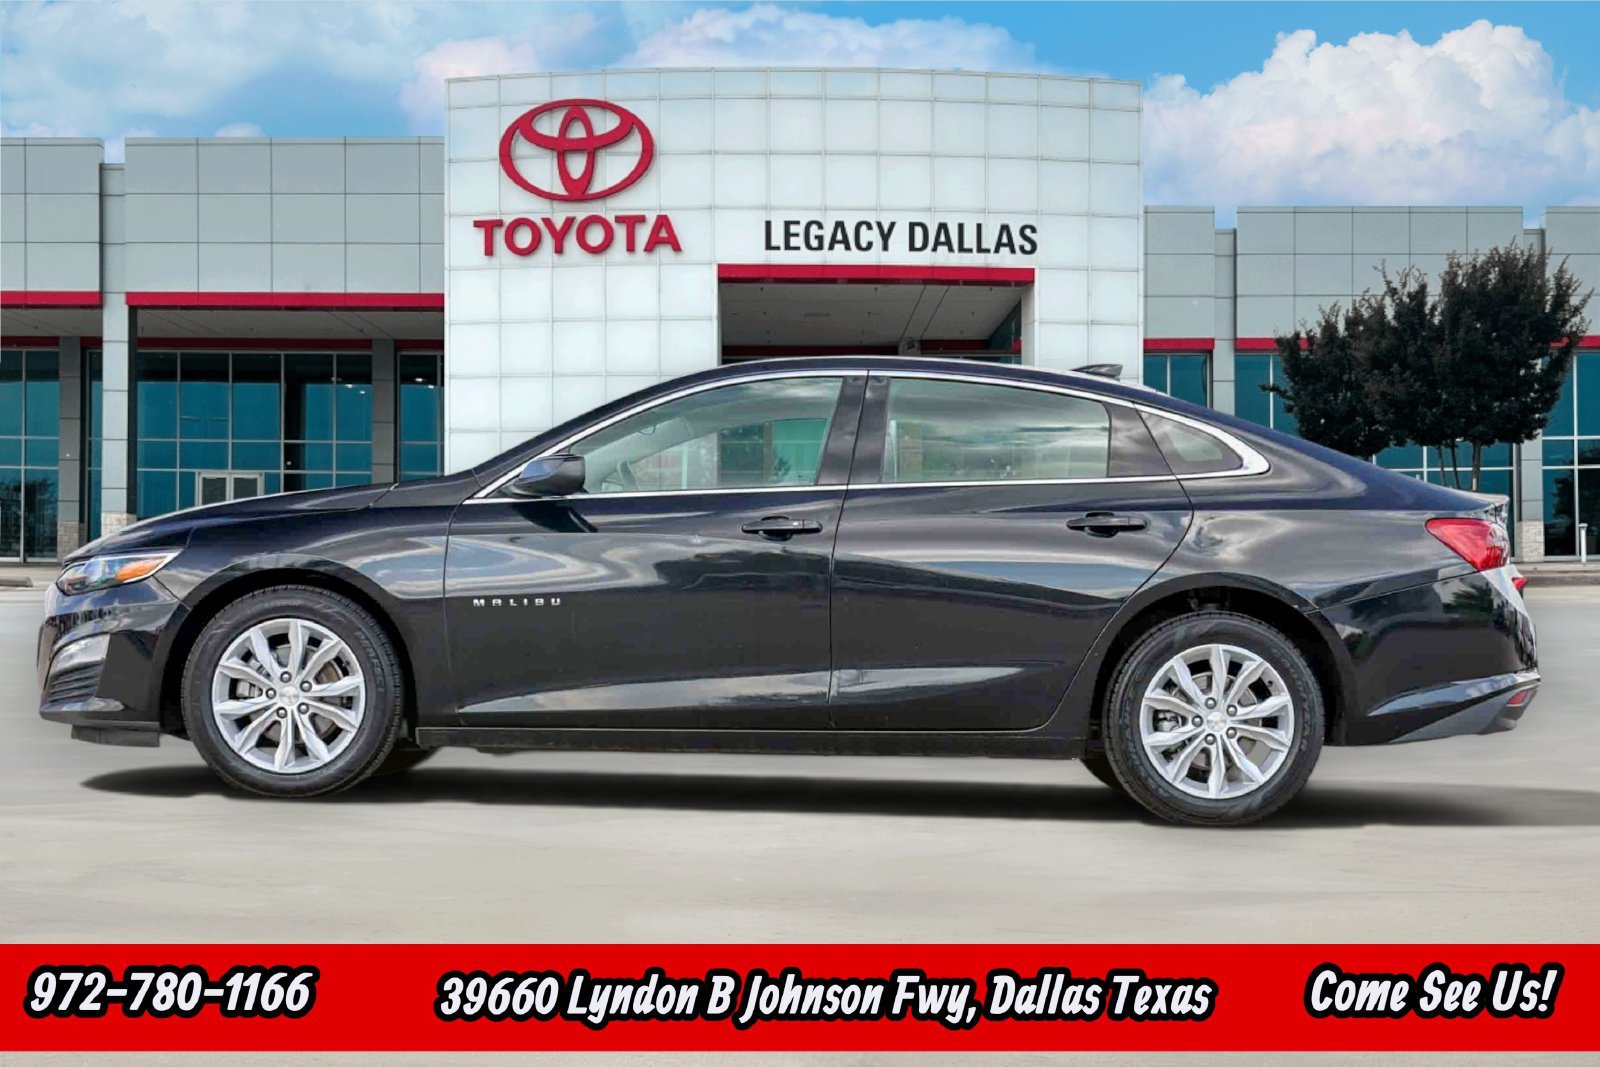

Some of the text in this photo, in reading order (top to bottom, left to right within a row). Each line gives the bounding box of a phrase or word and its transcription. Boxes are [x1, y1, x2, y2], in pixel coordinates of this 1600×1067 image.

[473, 213, 682, 257] TOYOTA
[764, 220, 1039, 255] LEGACY DALLAS
[472, 598, 561, 607] MALIBU
